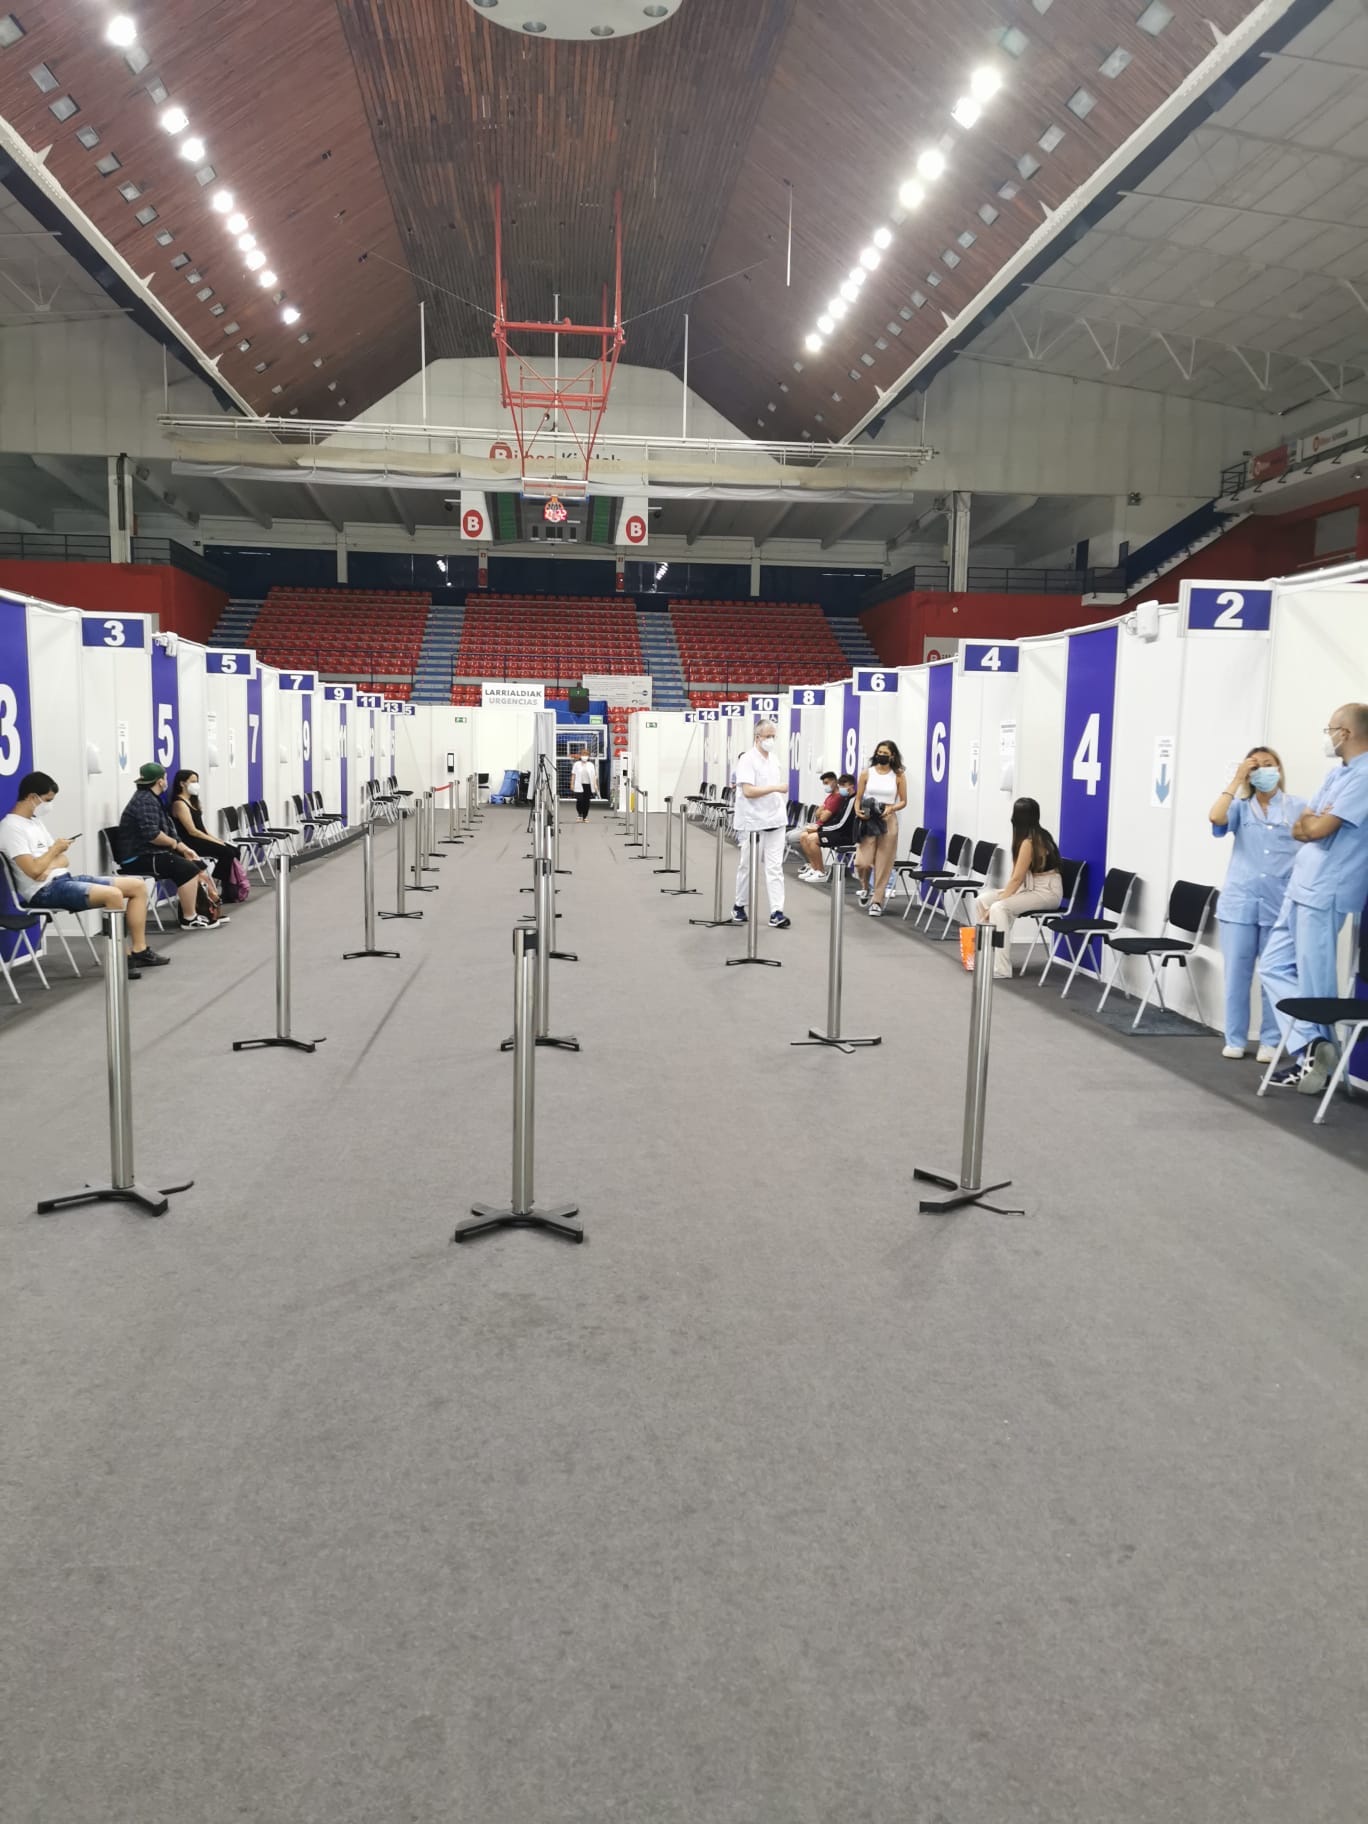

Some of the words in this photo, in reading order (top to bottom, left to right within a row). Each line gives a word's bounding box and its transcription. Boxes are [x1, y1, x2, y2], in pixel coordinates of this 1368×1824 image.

[467, 516, 480, 532] B
[630, 521, 643, 537] B
[1214, 591, 1244, 628] 2
[104, 620, 125, 646] 3
[221, 655, 237, 673] 5
[980, 646, 1001, 671] 4
[290, 675, 303, 690] 7
[870, 673, 885, 692] 6
[333, 688, 345, 700] 9
[360, 696, 376, 707] 11
[485, 689, 542, 698] LARRIALDIAK
[488, 697, 538, 706] URGENCIAS
[802, 690, 815, 705] 8
[384, 702, 399, 713] 13
[725, 705, 741, 716] 12
[755, 698, 774, 711] 10
[701, 711, 716, 720] 14
[0, 683, 21, 776] 3
[157, 703, 175, 768] 5
[249, 713, 260, 764] 7
[303, 720, 311, 761] 9
[790, 731, 800, 770] 10
[845, 728, 857, 775] 8
[931, 721, 946, 783] 6
[1073, 713, 1102, 796] 4
